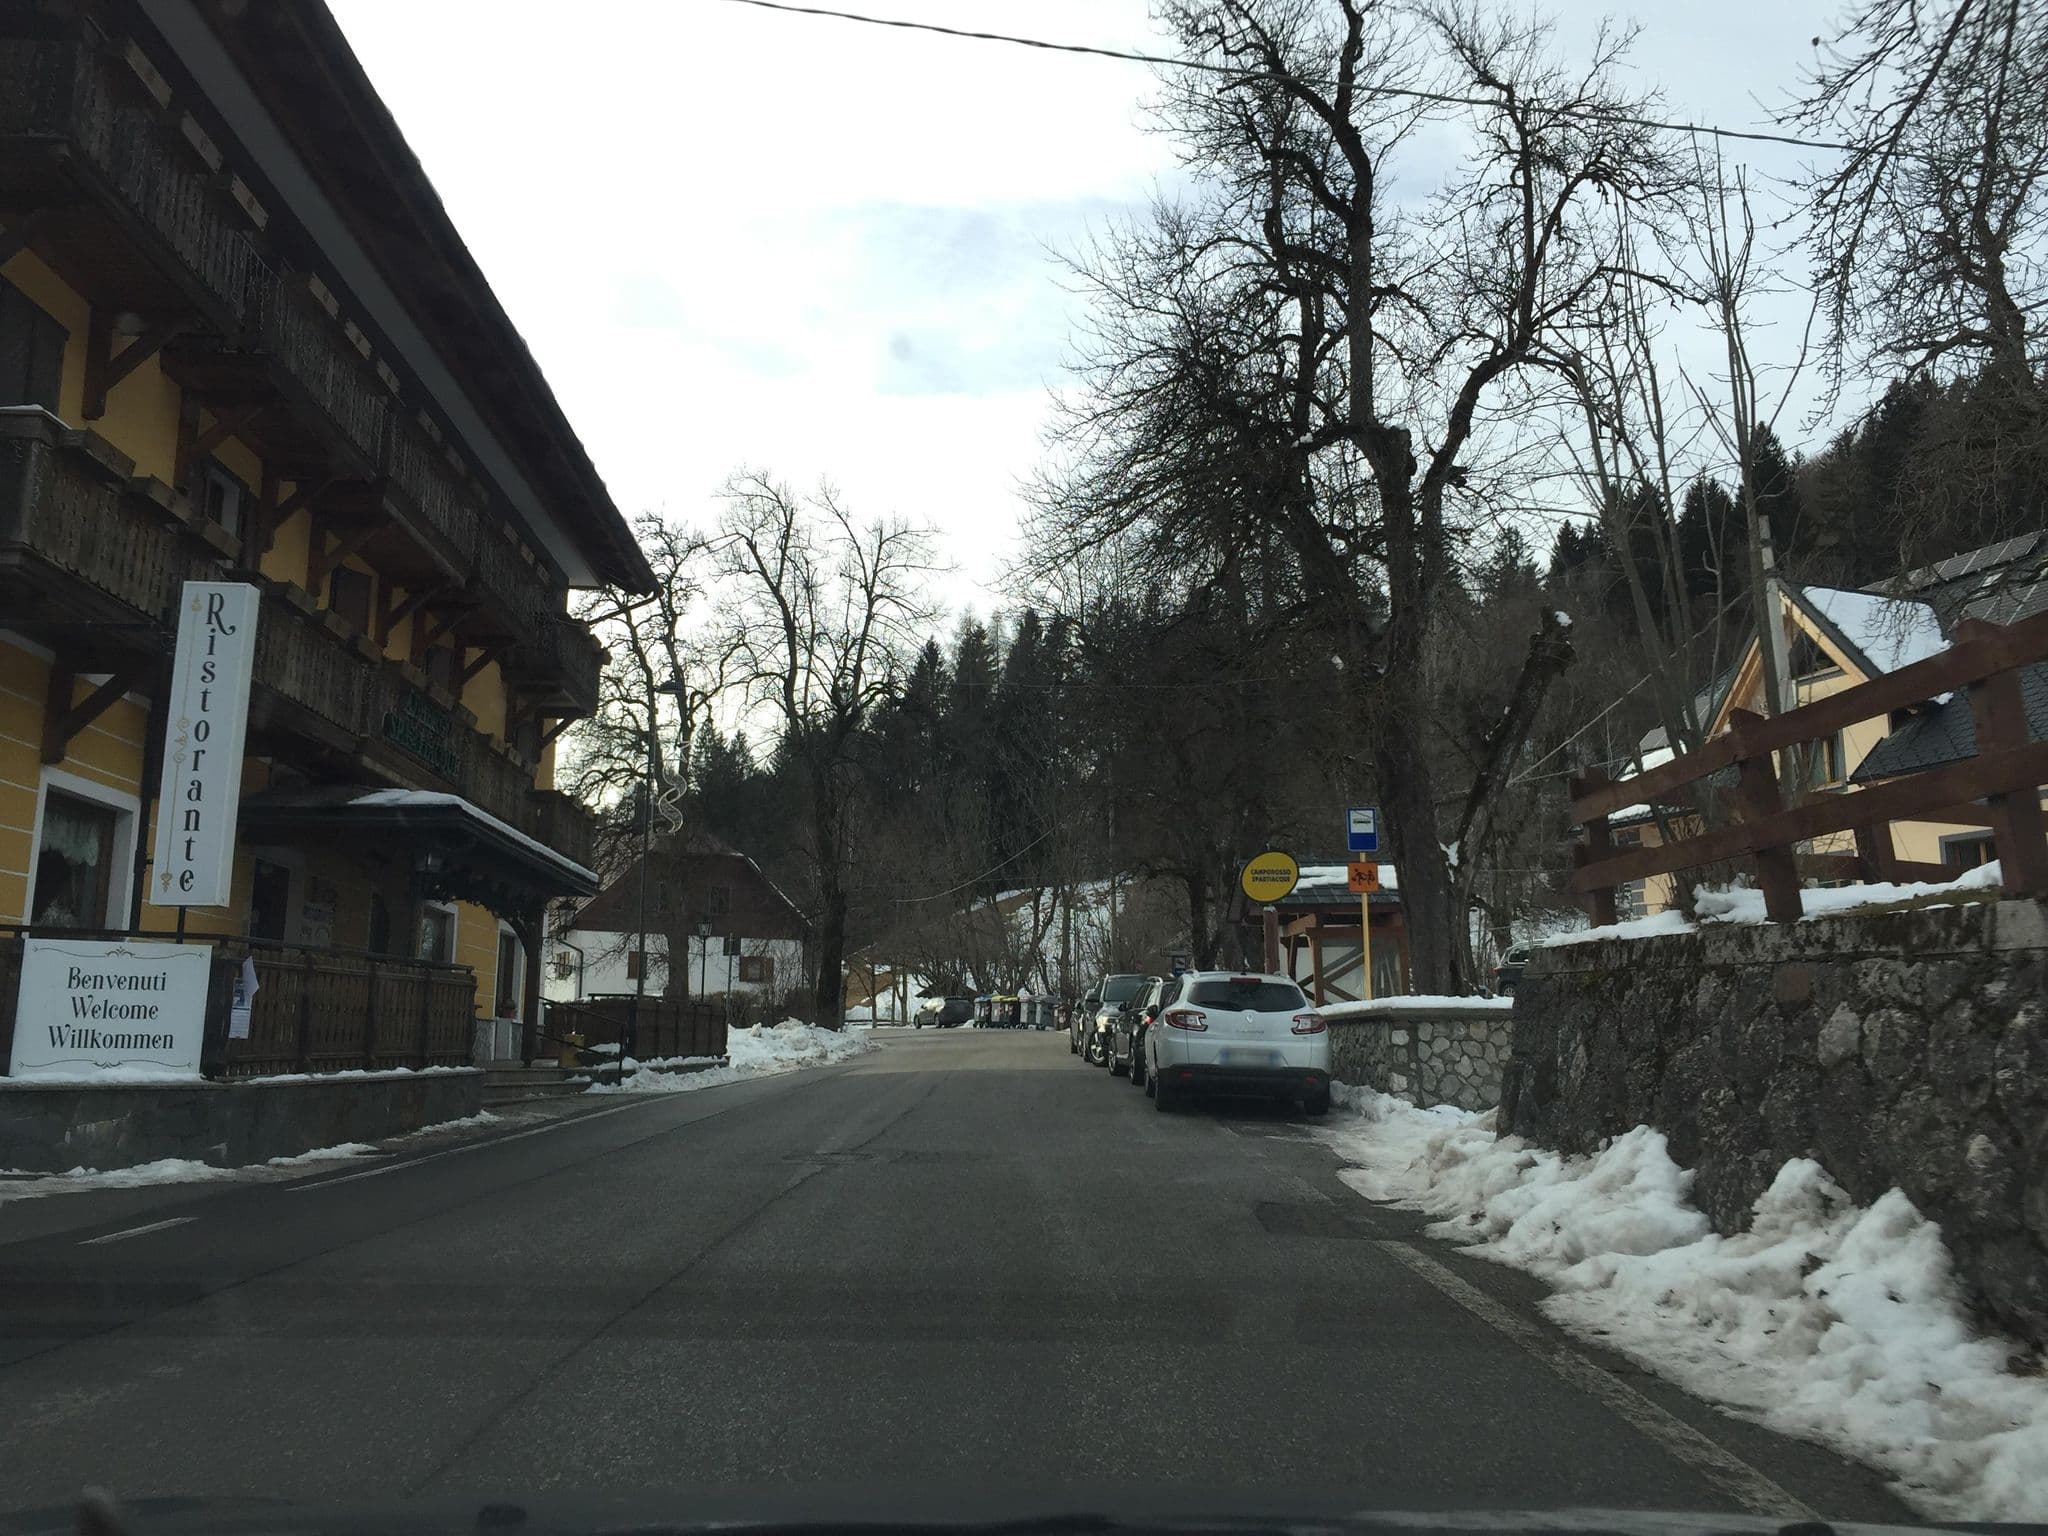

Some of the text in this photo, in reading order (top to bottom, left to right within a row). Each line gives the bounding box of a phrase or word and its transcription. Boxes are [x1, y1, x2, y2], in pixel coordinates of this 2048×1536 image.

[178, 592, 236, 893] Ristorante
[67, 966, 167, 992] Benvenuti
[70, 996, 159, 1021] Welcome
[48, 1025, 174, 1050] Willkommen
